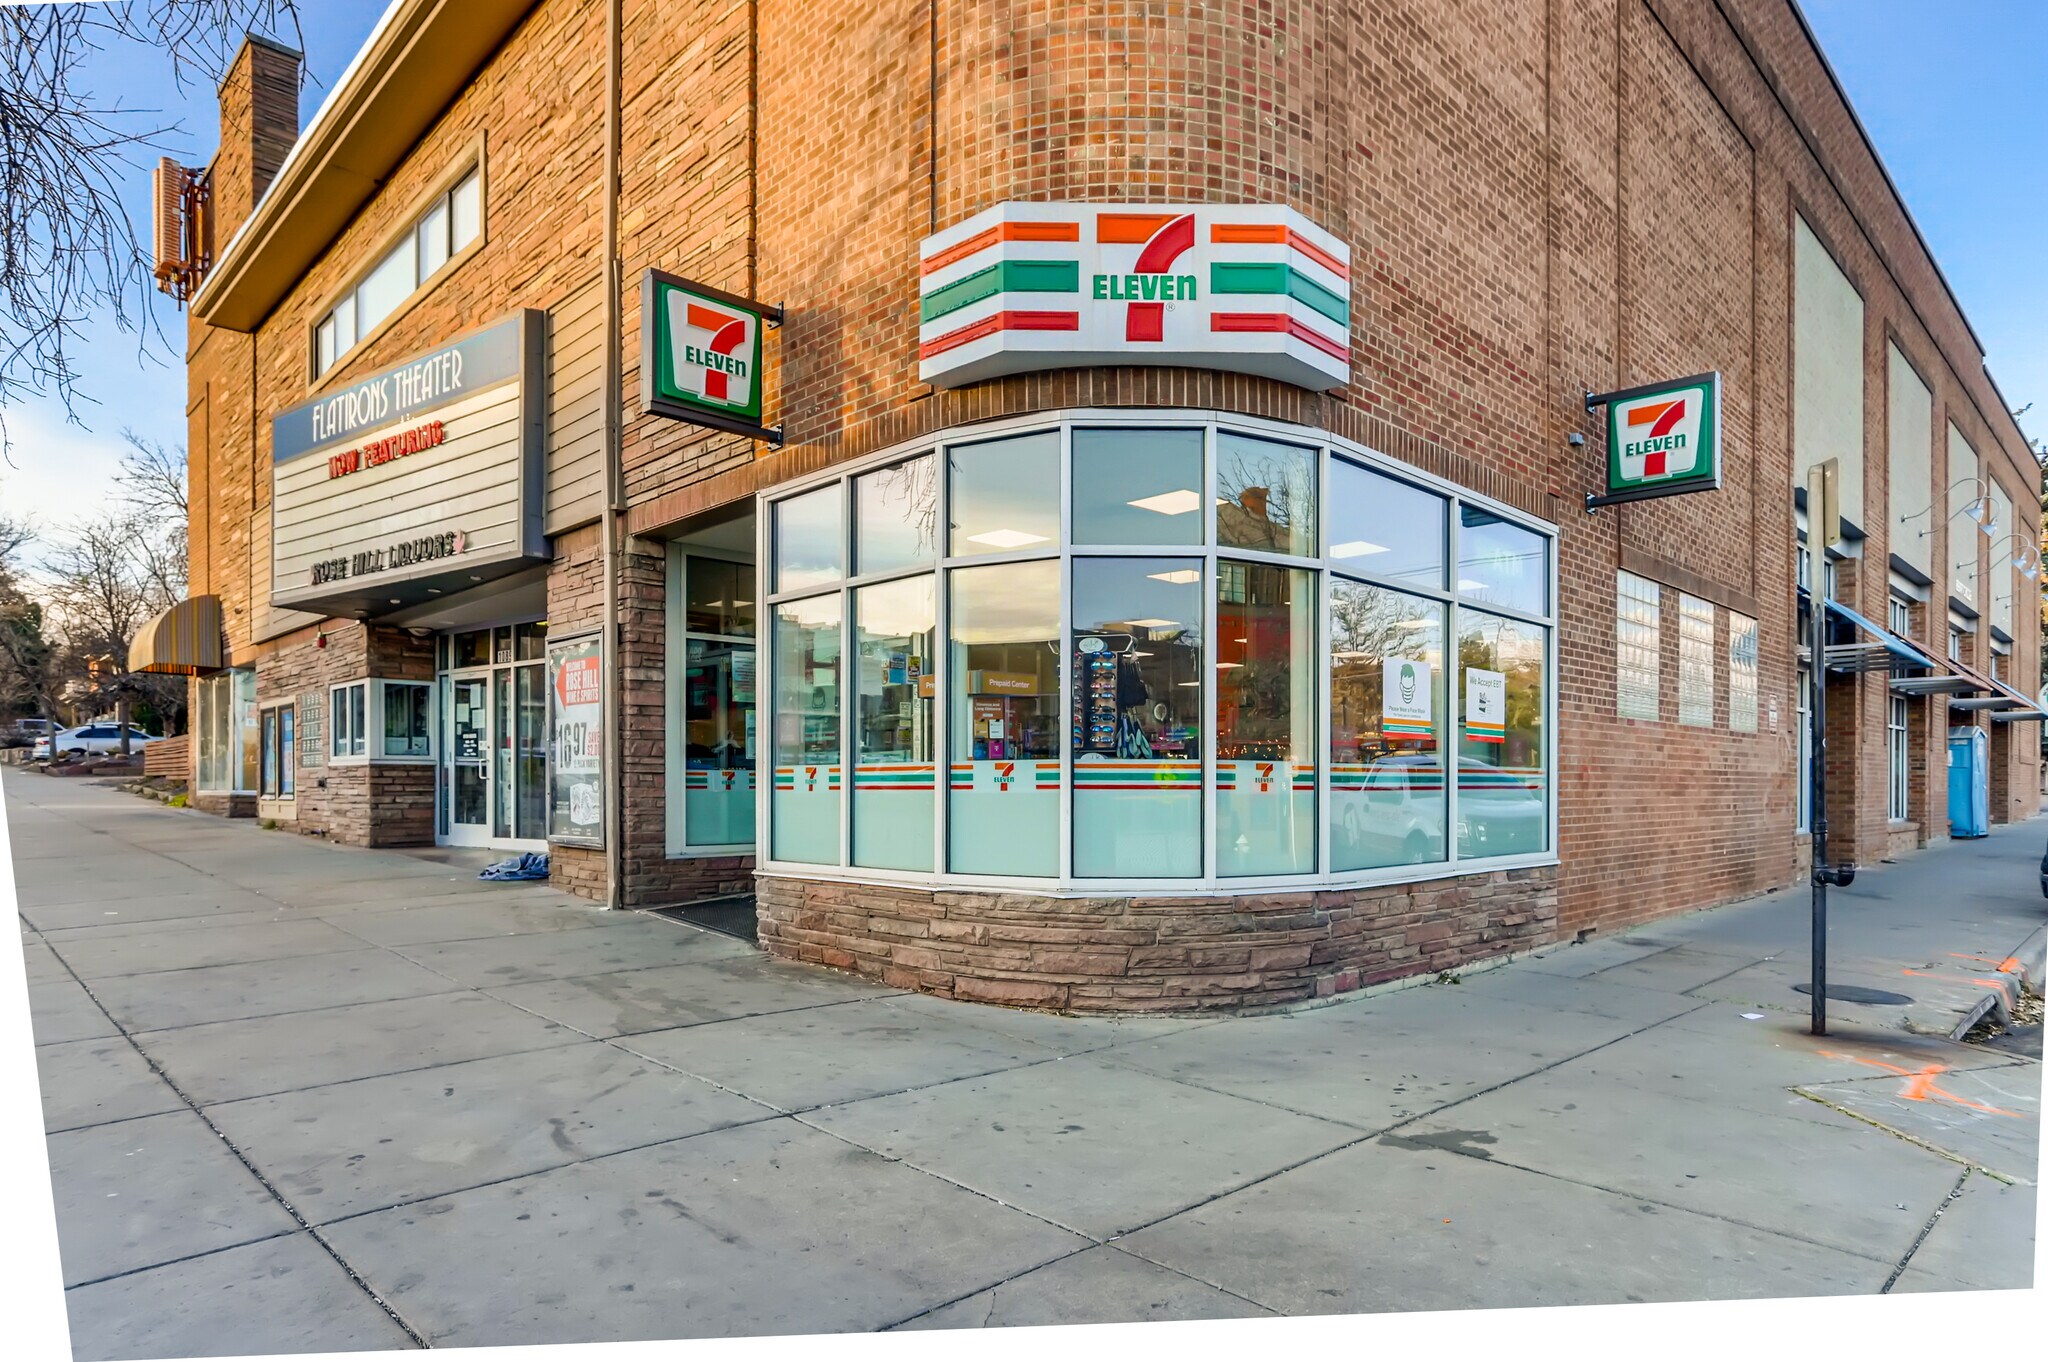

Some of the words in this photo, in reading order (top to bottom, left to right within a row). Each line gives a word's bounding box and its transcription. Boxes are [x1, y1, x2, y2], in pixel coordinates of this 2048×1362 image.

[1097, 213, 1195, 342] 7
[687, 303, 746, 400] 7
[312, 378, 388, 442] FLATIRONS
[393, 350, 462, 411] THEATER
[328, 448, 359, 480] NOW
[362, 420, 444, 468] FEATURING
[1628, 399, 1686, 477] 7
[311, 557, 347, 586] ROSE
[352, 548, 382, 577] HILL
[389, 530, 455, 569] LIQUORS
[565, 671, 581, 691] ROSE
[582, 668, 599, 689] HILL
[581, 688, 599, 702] SPIRITS
[989, 678, 1011, 688] Prepaid
[1011, 680, 1030, 689] Center
[1470, 675, 1477, 685] We
[1477, 677, 1493, 688] Accept
[1493, 679, 1502, 689] EBT
[573, 722, 587, 756] 97
[995, 763, 1014, 791] 7
[1255, 761, 1274, 791] 7
